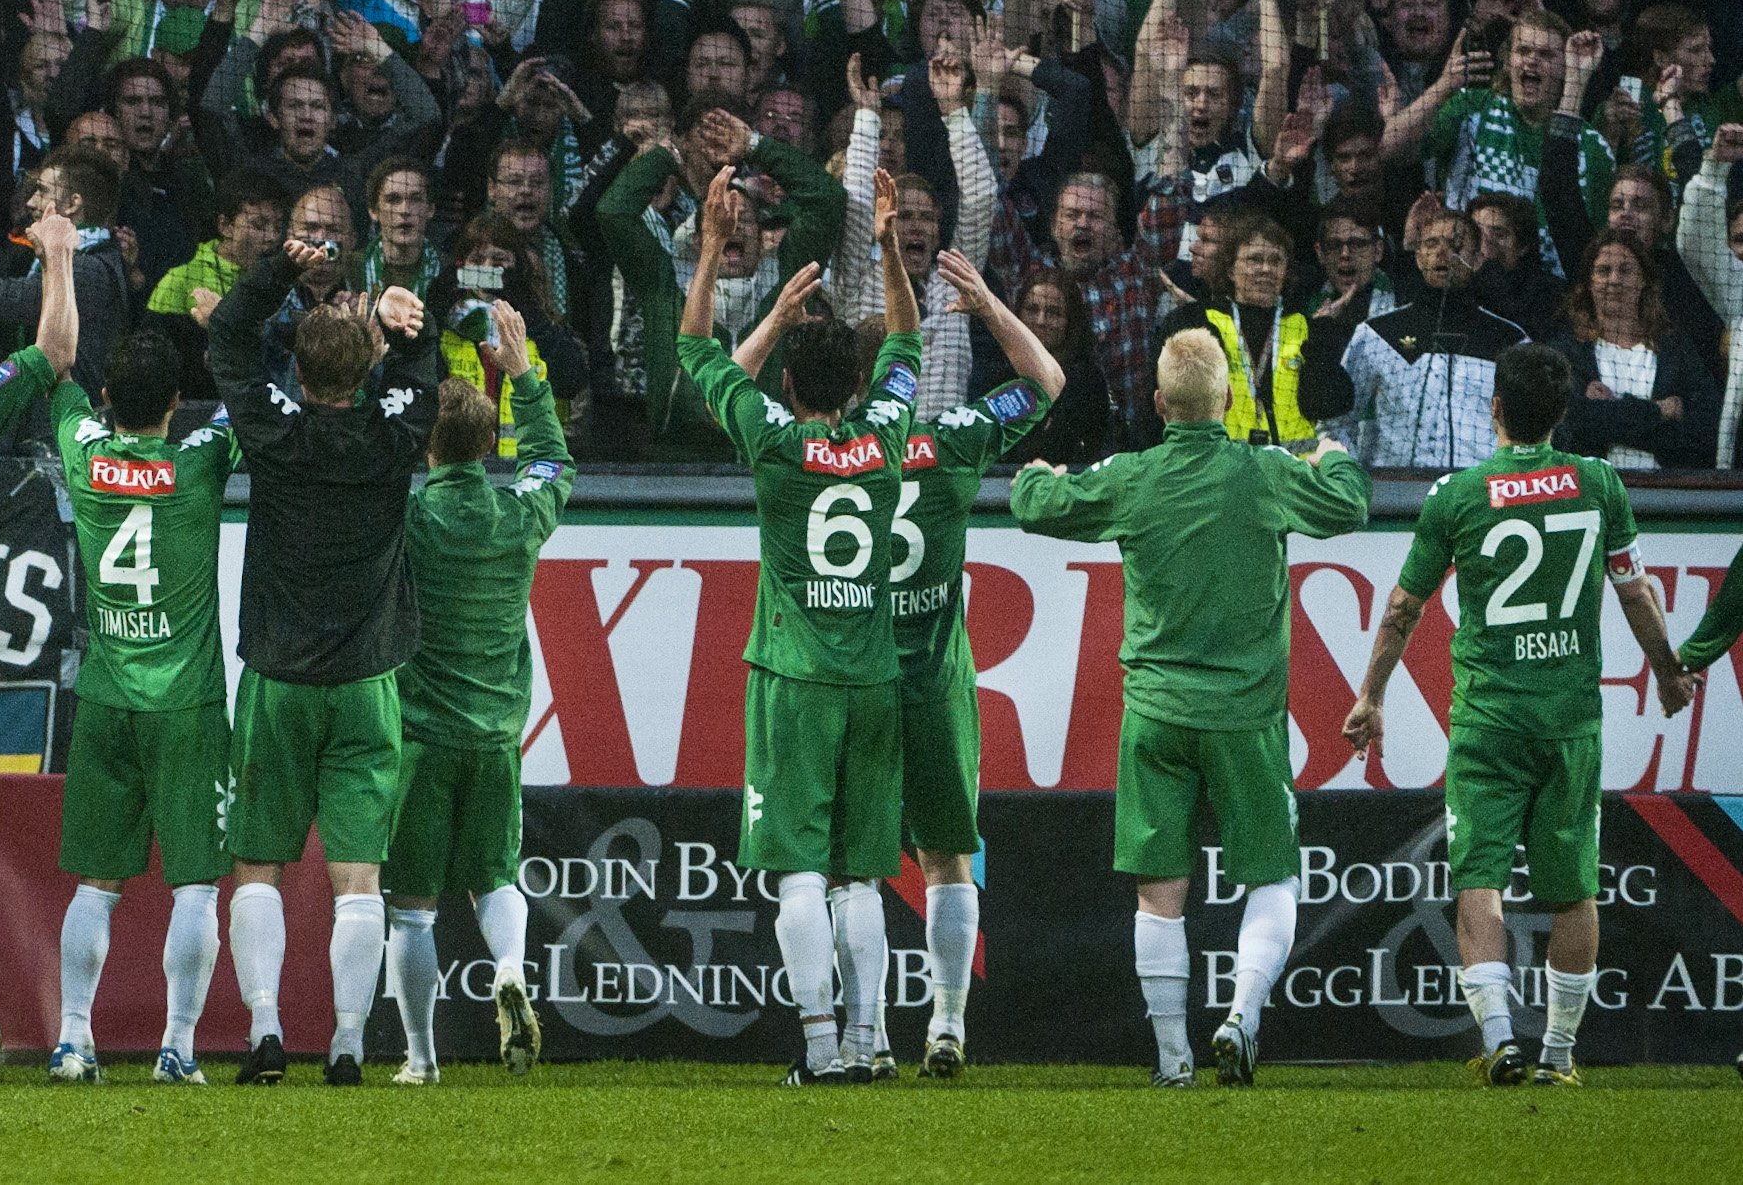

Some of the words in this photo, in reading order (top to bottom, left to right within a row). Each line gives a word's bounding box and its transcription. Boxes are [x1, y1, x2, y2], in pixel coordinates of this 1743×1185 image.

[92, 461, 173, 489] FOLKIA
[806, 441, 882, 469] FOLKIA
[1489, 473, 1577, 499] FOLKIA
[807, 483, 874, 579] 6
[99, 504, 160, 605] 4
[1480, 510, 1601, 626] 27
[97, 611, 171, 638] TIMISELA
[1515, 629, 1581, 661] BESARA
[518, 856, 660, 900] ODIN
[674, 841, 782, 903] BYG
[1647, 951, 1743, 1012] AB
